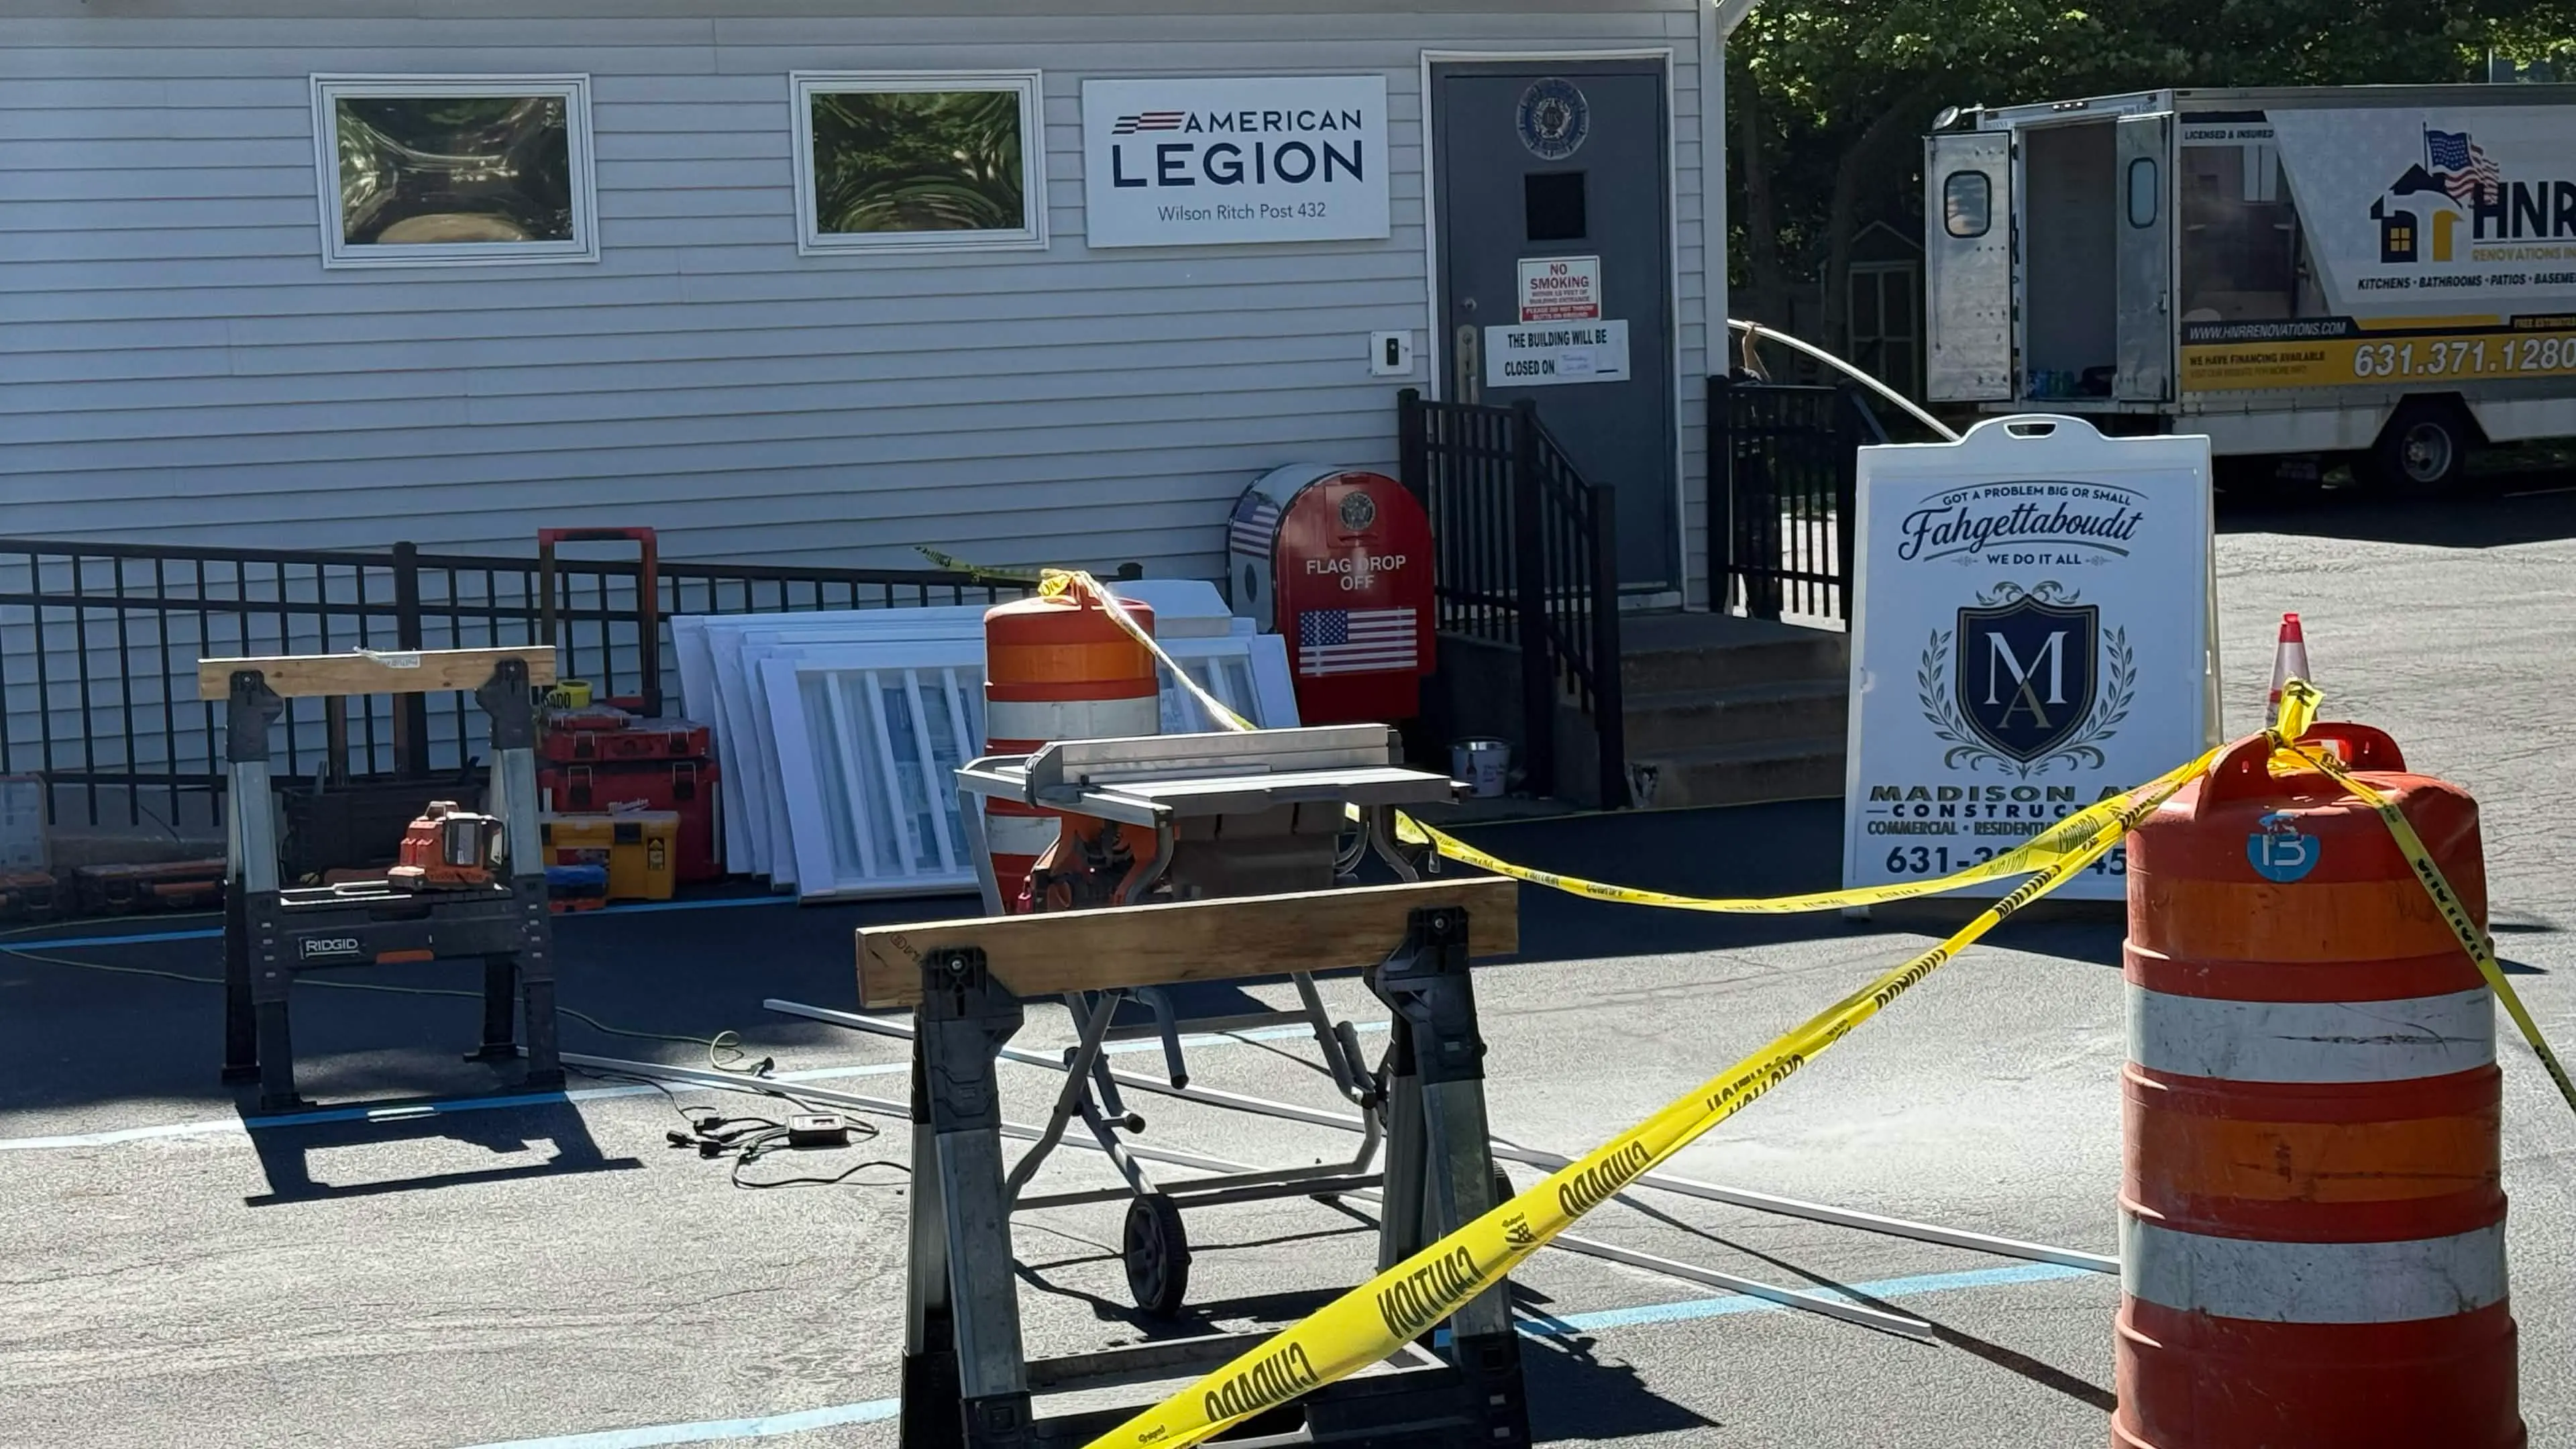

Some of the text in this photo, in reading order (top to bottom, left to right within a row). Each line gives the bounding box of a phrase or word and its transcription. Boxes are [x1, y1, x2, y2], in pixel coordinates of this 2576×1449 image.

[1184, 109, 1362, 133] AMERICAN
[2185, 130, 2226, 140] LICENSED
[2237, 129, 2274, 138] INSURED
[1112, 140, 1363, 188] LEGION
[1158, 203, 1326, 221] Wilson Ritch Post 432
[2473, 180, 2576, 239] HNR
[2472, 247, 2561, 262] RENOVATIONS
[1550, 264, 1567, 275] NO
[1529, 276, 1589, 289] SMOKING
[2358, 277, 2411, 291] KITCHENS
[2419, 275, 2482, 288] BATHROOMS
[2490, 274, 2526, 286] PATIOS
[1508, 329, 1607, 348] THE BUILDING WILL BE
[2190, 321, 2347, 341] WWW.HNRRENOVATIONS.COM
[2190, 351, 2325, 366] WE HAVE FINANCING AVAILABLE
[2354, 337, 2576, 377] 631.371.1280
[1505, 360, 1539, 376] CLOSED
[1542, 360, 1555, 374] ON
[1942, 486, 2131, 506] GOT A PROBLEM BIG OR SMALL
[1307, 555, 1406, 575] FLAG DROP
[1987, 553, 2082, 564] WE DO IT ALL
[1340, 574, 1375, 591] OFF
[1869, 786, 2076, 802] MADISON
[1868, 821, 1958, 835] COMMERCIAL
[305, 938, 358, 953] RIDGID
